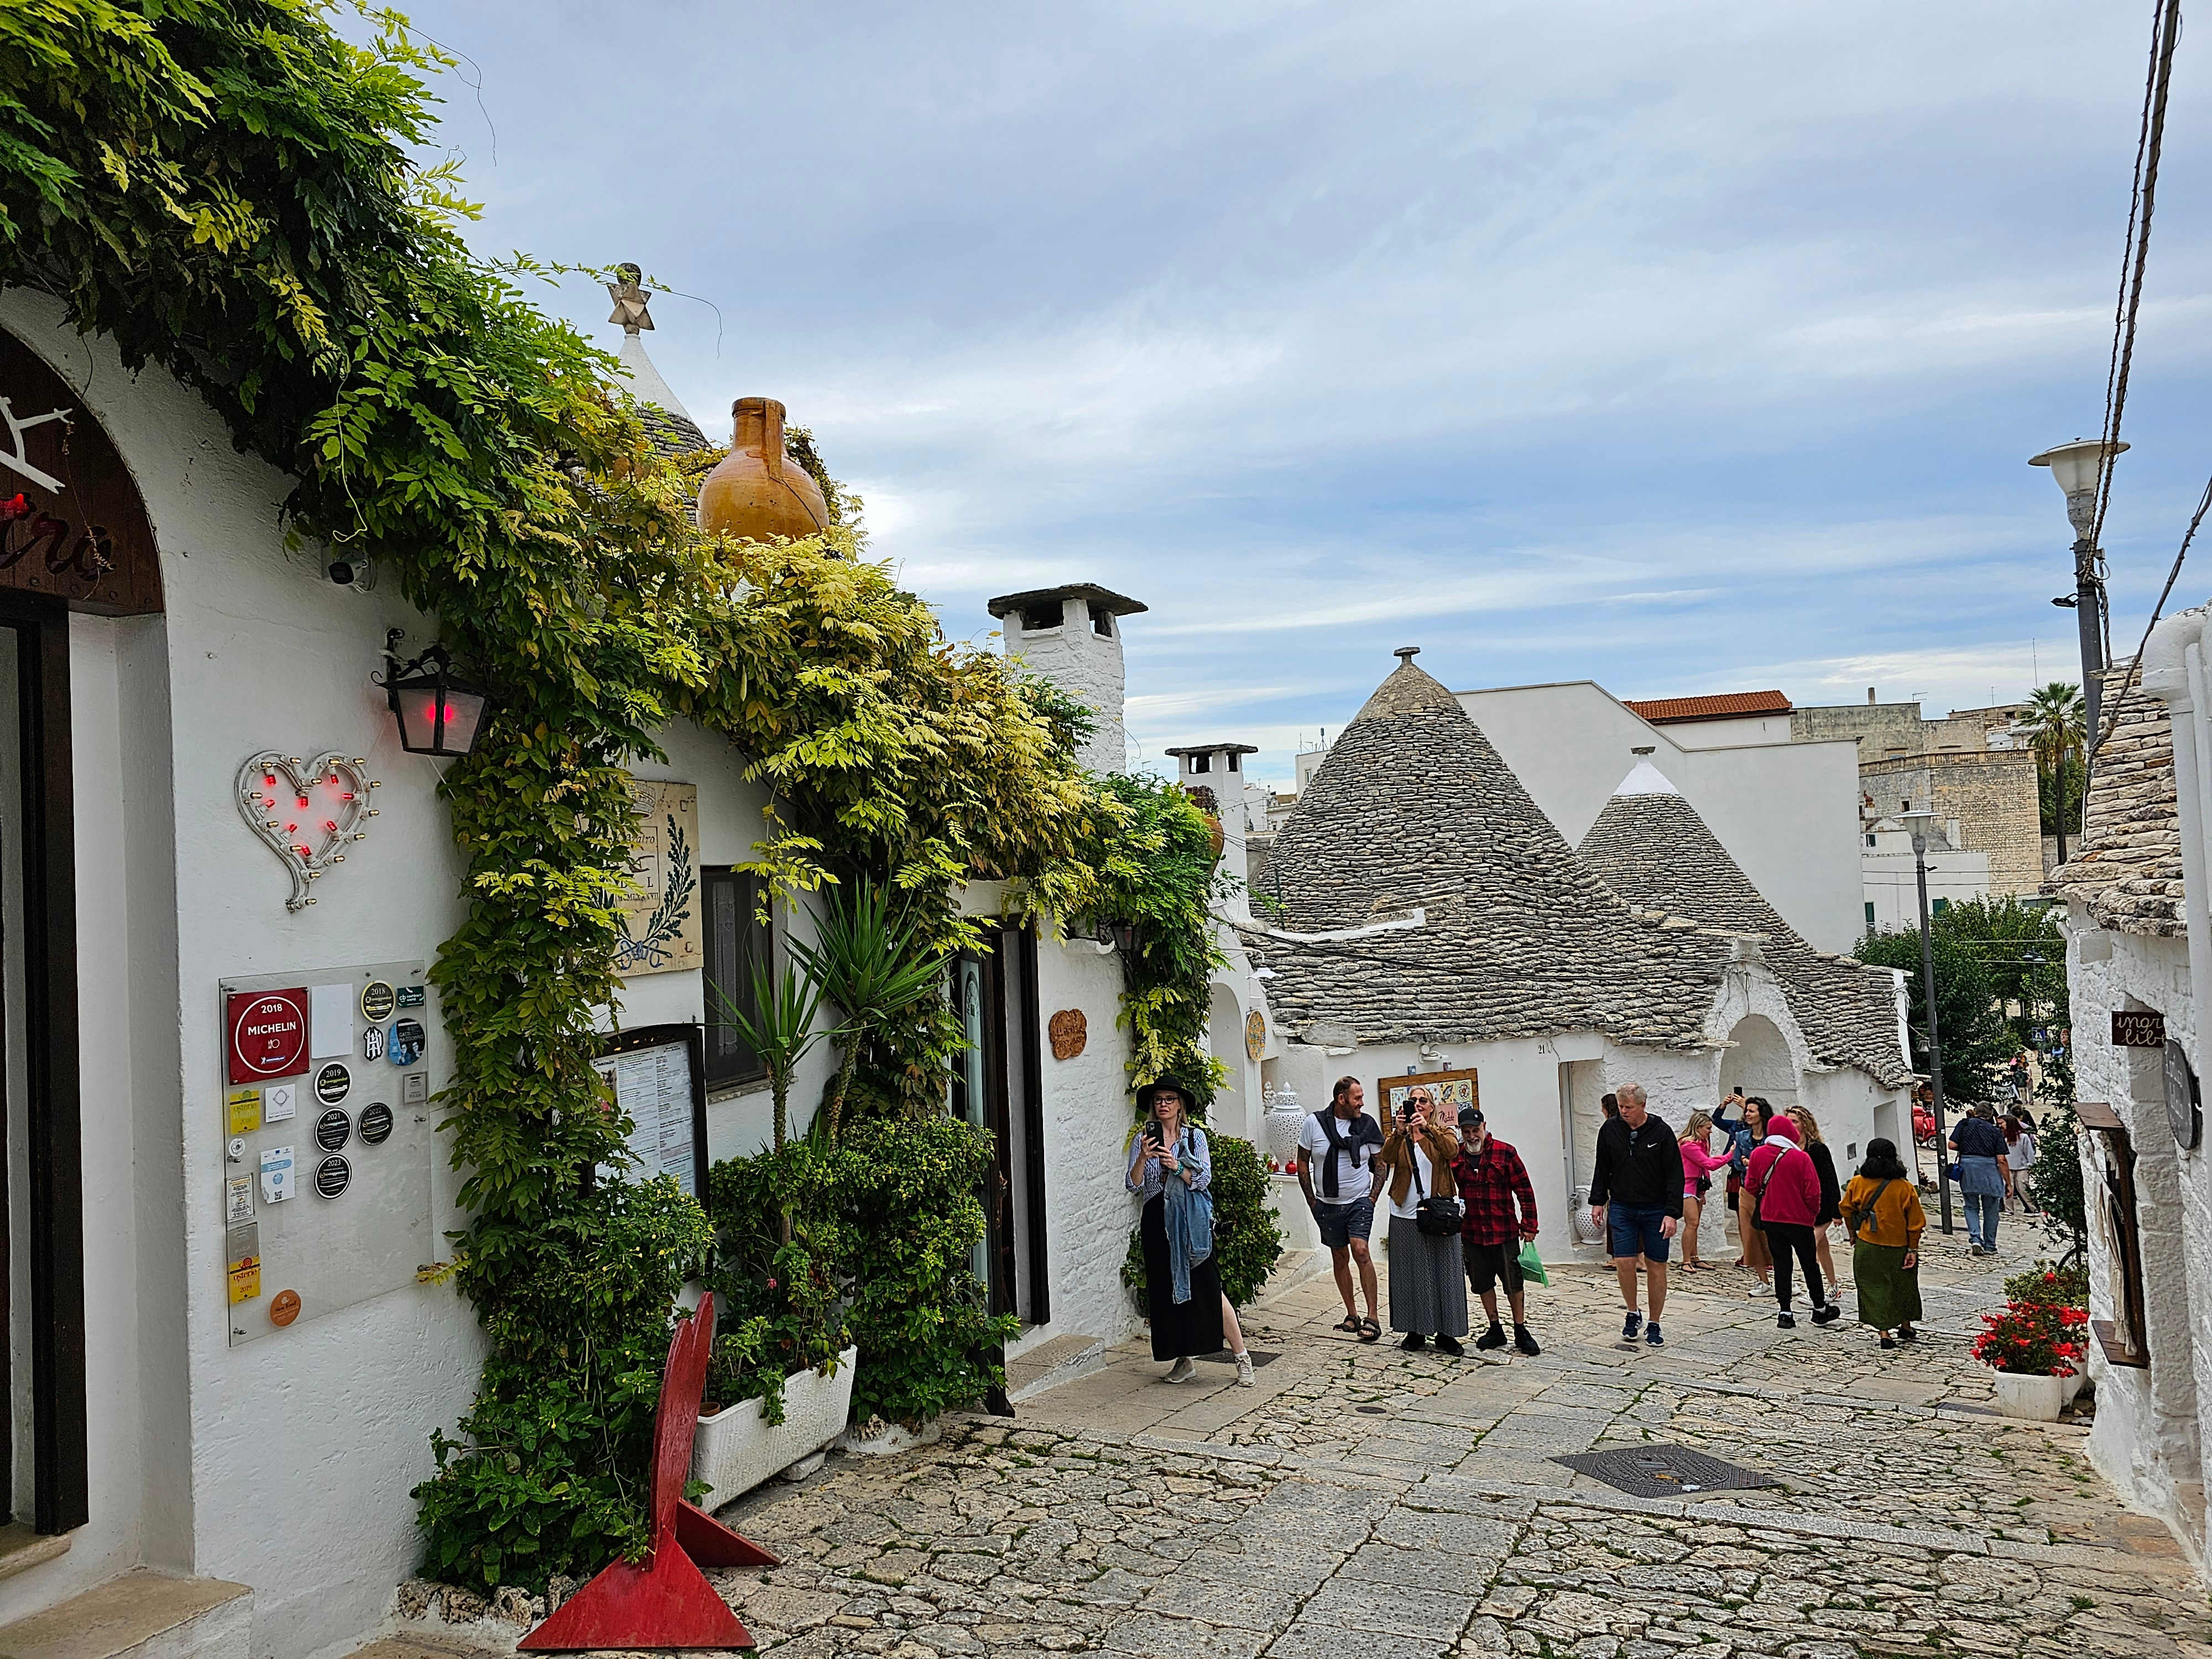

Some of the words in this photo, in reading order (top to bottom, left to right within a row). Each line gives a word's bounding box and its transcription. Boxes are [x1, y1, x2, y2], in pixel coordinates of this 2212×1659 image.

[647, 877, 654, 888] L
[260, 1003, 283, 1014] 2018
[248, 1021, 296, 1036] MICHELIN
[1538, 1045, 1545, 1054] 21
[326, 1068, 341, 1077] 2019
[369, 1107, 382, 1115] 2022
[327, 1113, 340, 1121] 2021
[239, 1285, 252, 1293] 2019
